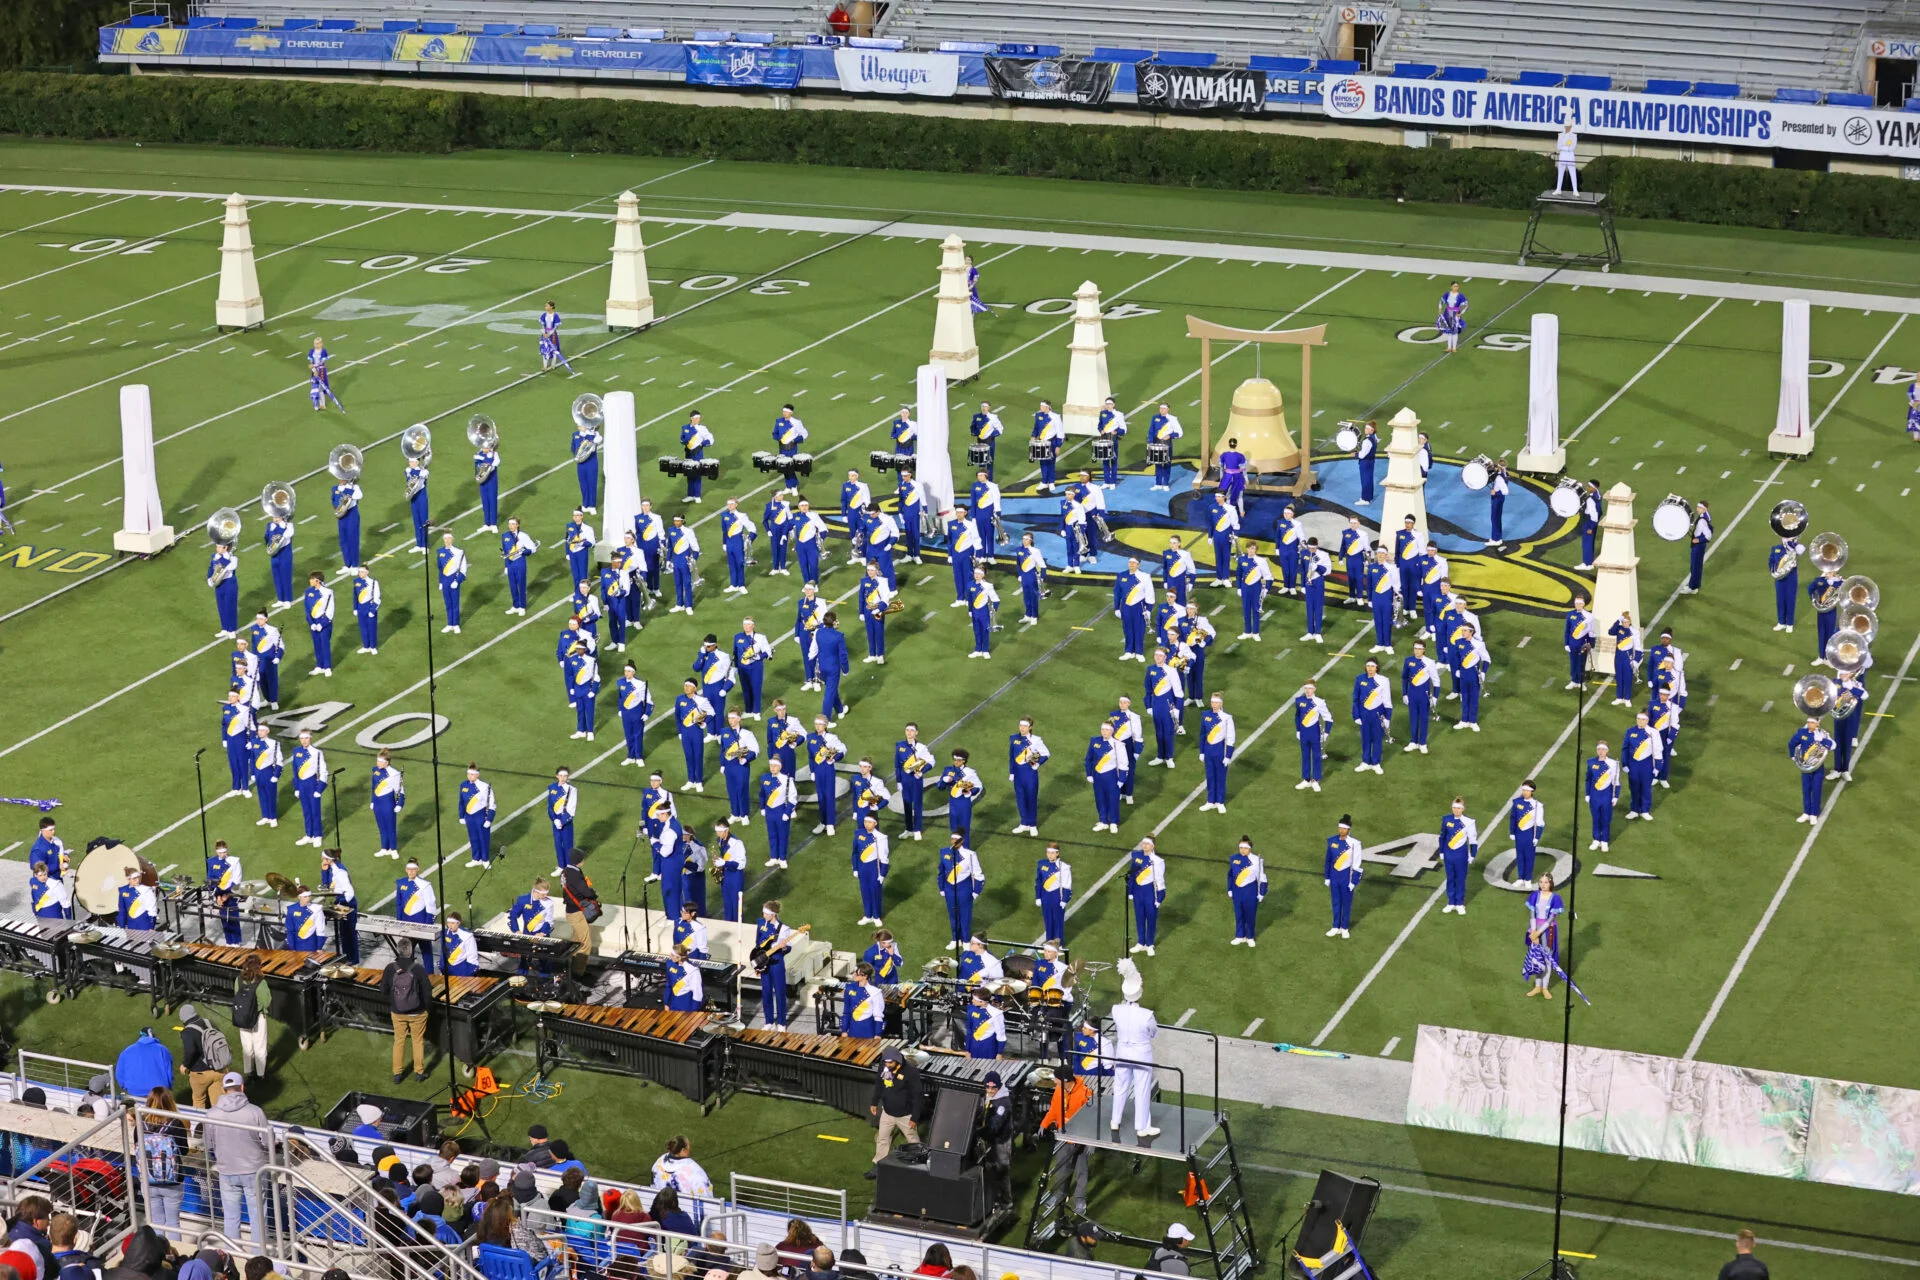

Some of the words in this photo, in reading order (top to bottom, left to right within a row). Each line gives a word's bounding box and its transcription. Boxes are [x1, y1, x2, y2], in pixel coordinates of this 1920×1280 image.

[286, 39, 345, 50] CHEVROLET
[581, 48, 643, 61] CHEVROLET
[729, 49, 755, 78] Indy
[860, 54, 930, 91] Wenger
[1171, 74, 1256, 104] YAMAHA
[1374, 84, 1446, 118] BANDS
[1452, 88, 1478, 119] OF
[1484, 91, 1581, 126] AMERICA
[1588, 97, 1772, 140] CHAMPIONSHIPS
[1782, 120, 1825, 135] Presented
[1826, 123, 1837, 138] by
